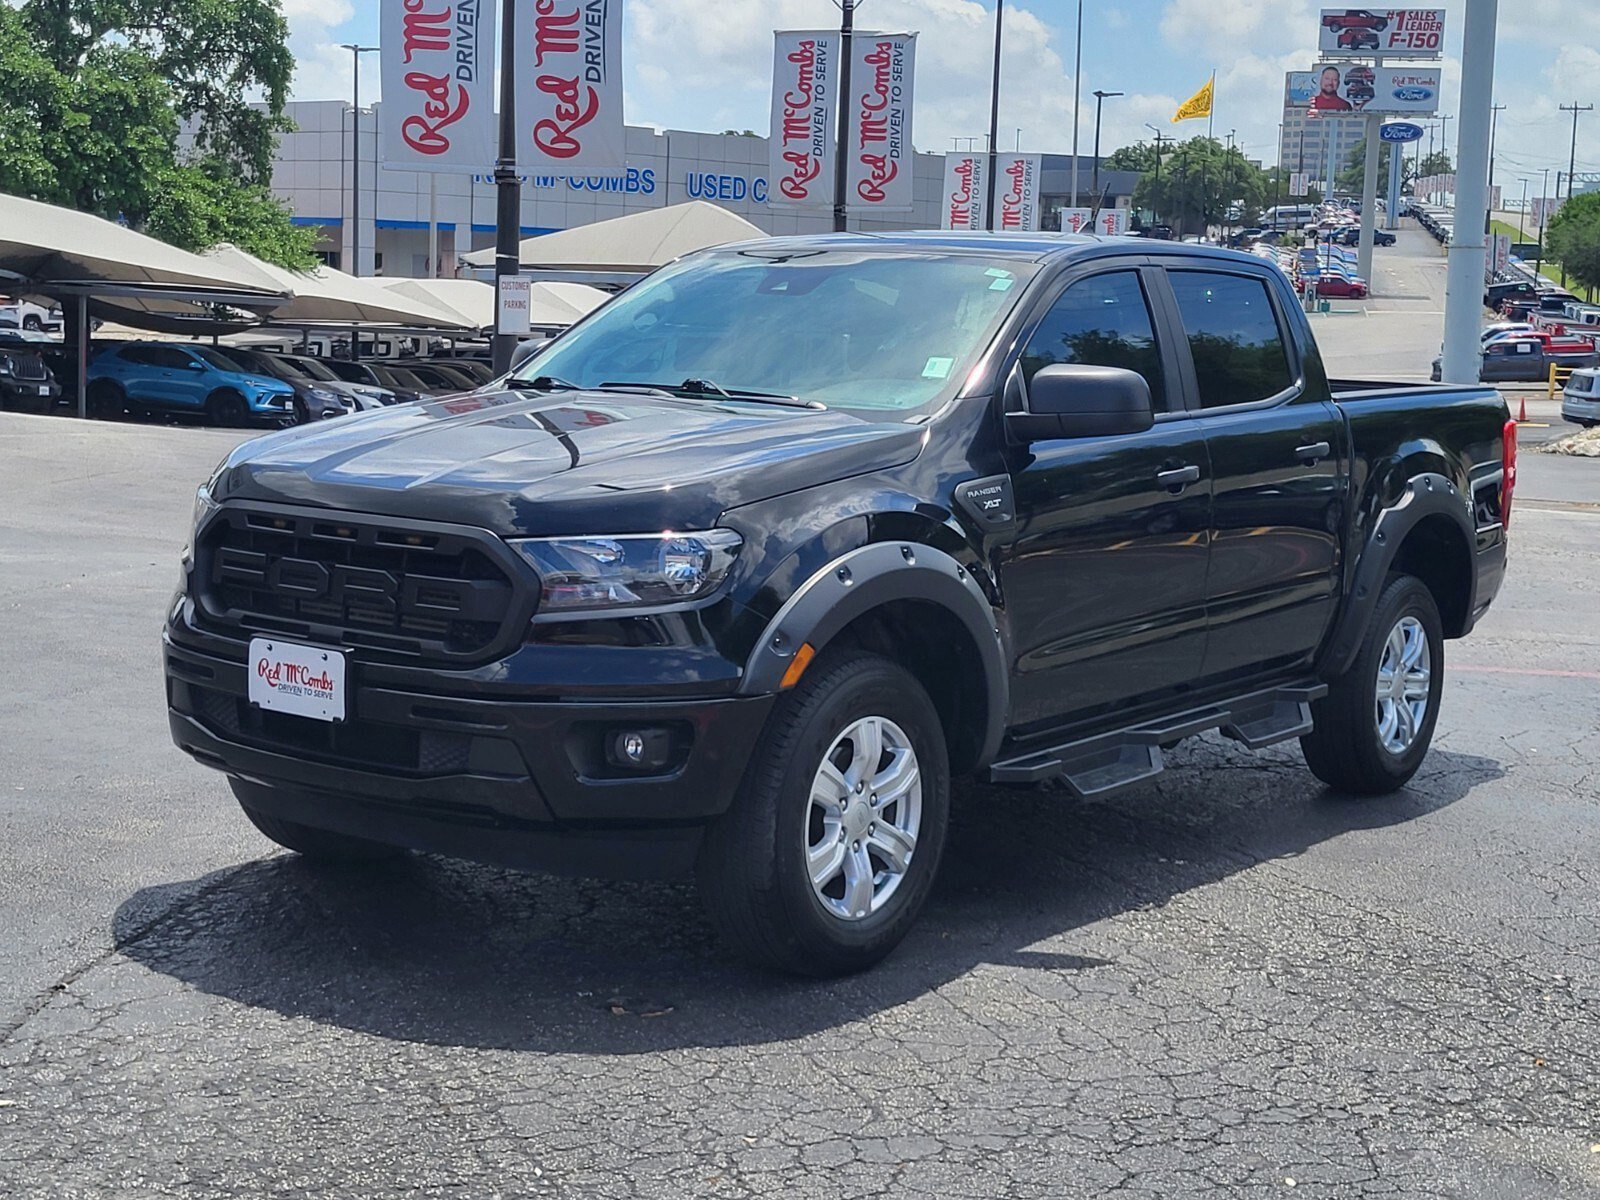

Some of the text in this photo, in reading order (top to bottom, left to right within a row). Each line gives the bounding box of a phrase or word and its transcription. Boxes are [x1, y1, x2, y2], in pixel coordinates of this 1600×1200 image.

[1405, 21, 1443, 31] LEADER
[1407, 11, 1438, 21] SALES
[456, 0, 474, 83] DRIVEN
[585, 0, 602, 84] DRIVEN
[1388, 32, 1440, 48] F-150
[402, 71, 470, 156] Red
[812, 40, 828, 157] DRIVEN TO SERVE
[890, 42, 904, 159] DRIVEN TO SERVE
[533, 74, 599, 159] Red
[780, 40, 821, 199] Red McCombs
[857, 42, 898, 202] Red McCombs
[1383, 126, 1414, 139] Ford
[688, 173, 747, 200] USED
[753, 178, 770, 202] C
[970, 158, 982, 231] RIVEN TO SERVE
[1022, 159, 1033, 231] RIVEN TO SERVE
[501, 281, 530, 290] CUSTOMER
[504, 299, 527, 309] PARKING
[967, 485, 1002, 498] RANGER
[983, 498, 1002, 510] XLT
[257, 657, 334, 691] Red McCombs
[278, 683, 334, 700] DRIVEN TO SERVE
